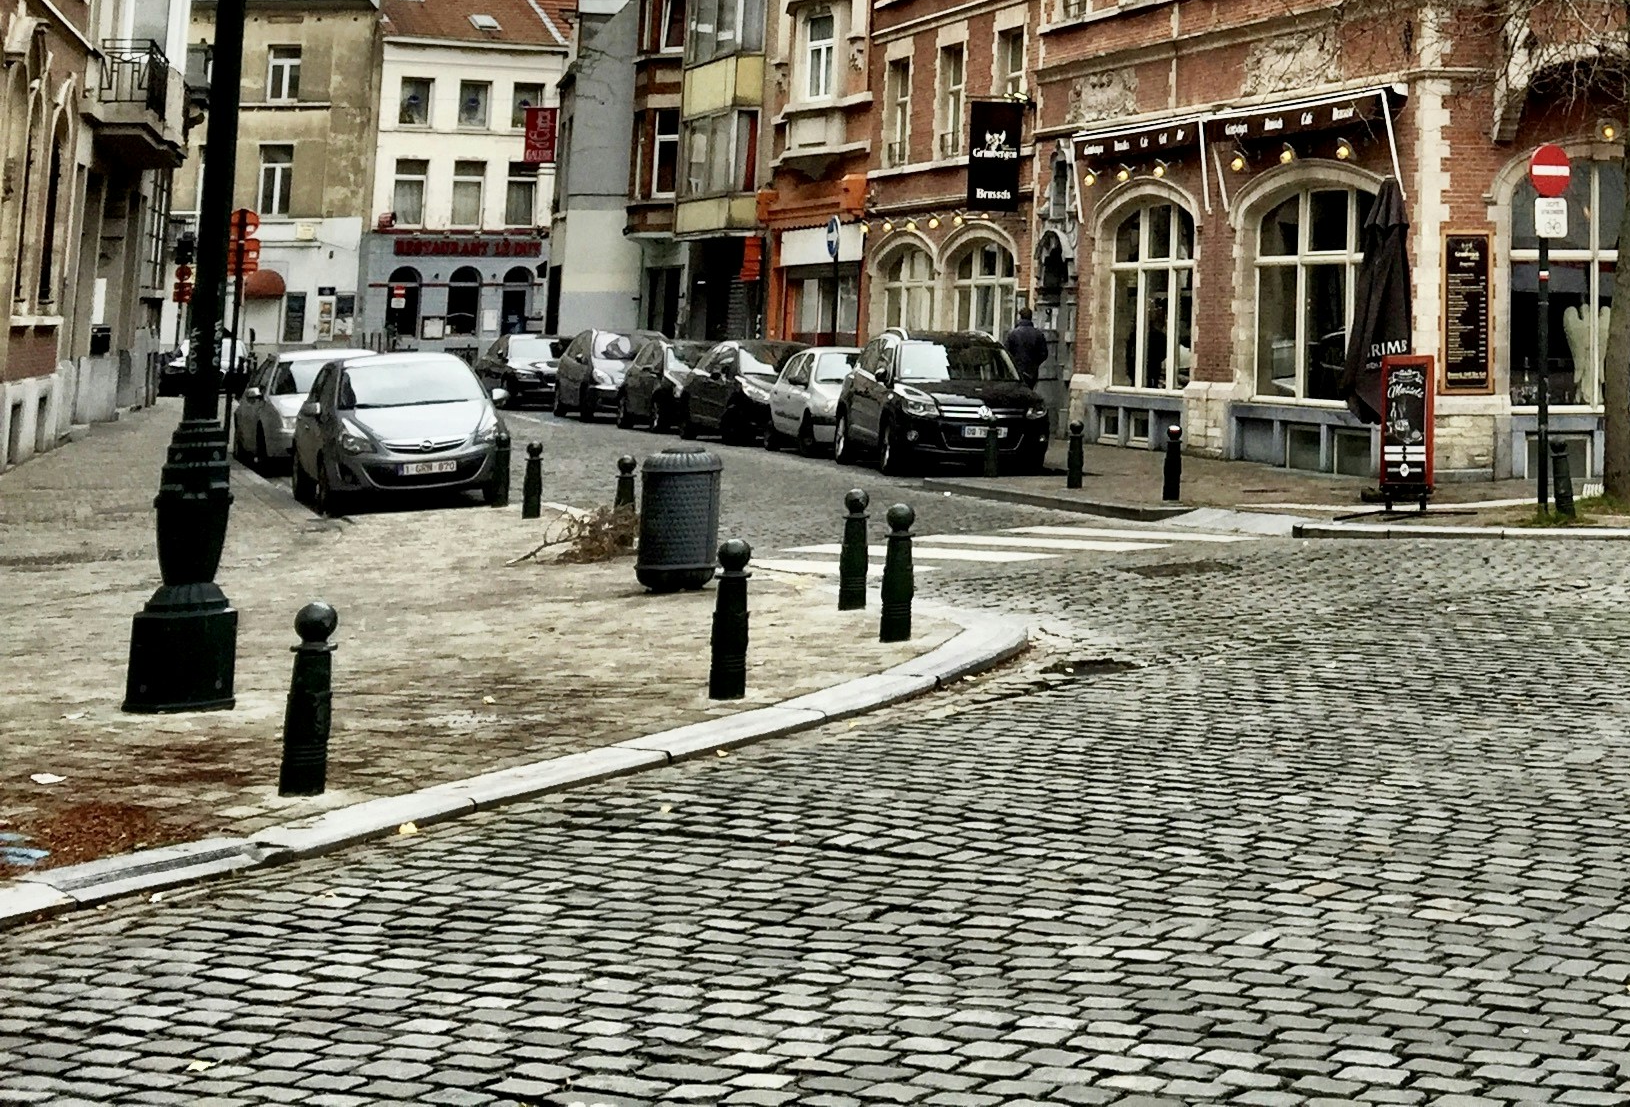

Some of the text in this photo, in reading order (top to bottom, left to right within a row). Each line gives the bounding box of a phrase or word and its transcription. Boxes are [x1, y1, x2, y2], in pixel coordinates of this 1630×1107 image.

[972, 147, 1018, 160] Grimbergen
[976, 187, 1011, 199] Brussels
[1367, 340, 1407, 358] RIMB
